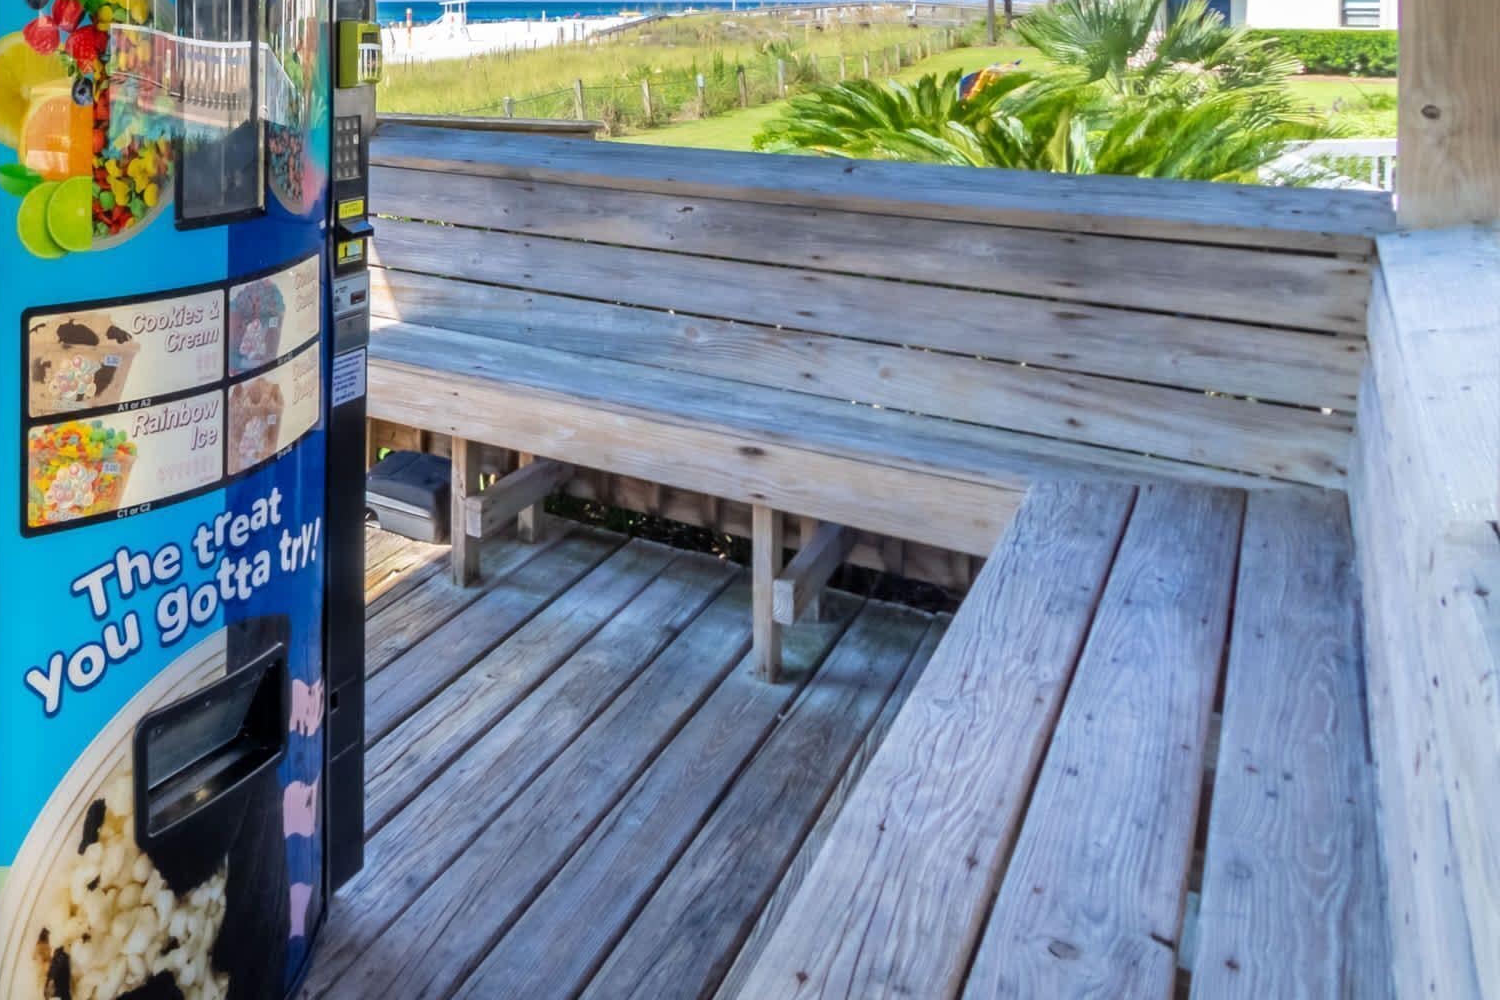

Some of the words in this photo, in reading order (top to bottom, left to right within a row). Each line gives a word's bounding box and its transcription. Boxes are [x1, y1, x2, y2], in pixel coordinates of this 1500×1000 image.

[132, 305, 204, 335] Cookies
[209, 300, 220, 320] &
[165, 328, 220, 353] Cream
[117, 403, 129, 412] A1
[130, 401, 139, 409] or
[132, 400, 220, 438] Rainbow
[190, 426, 218, 451] Ice
[117, 509, 128, 519] C1
[129, 507, 139, 516] or
[71, 544, 182, 618] The
[193, 487, 283, 564] treat
[25, 612, 142, 714] you
[156, 549, 272, 644] gotta
[279, 516, 322, 573] try!
